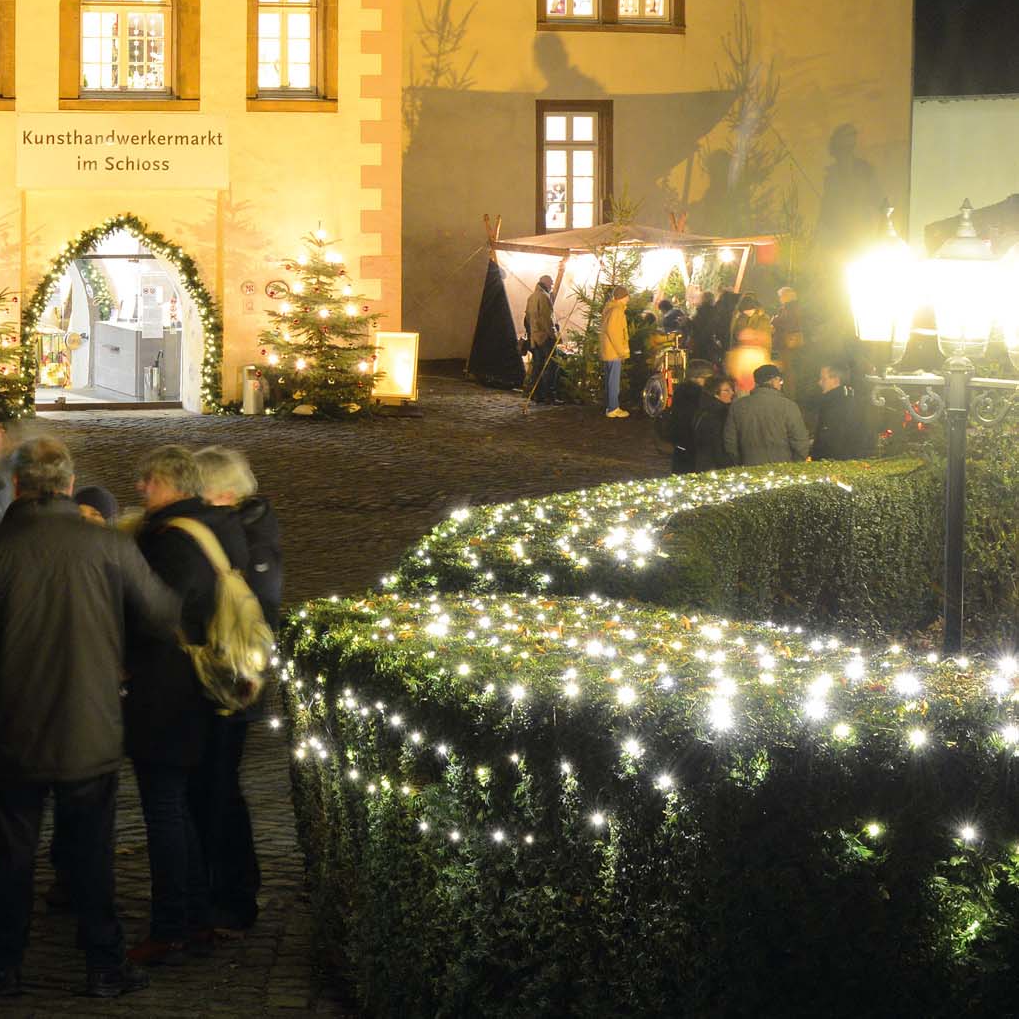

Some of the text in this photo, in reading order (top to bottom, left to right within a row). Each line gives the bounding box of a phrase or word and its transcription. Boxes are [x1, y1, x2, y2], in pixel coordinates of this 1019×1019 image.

[22, 129, 223, 146] Kunsthandwerkermarkt
[77, 155, 170, 171] im Schloss
